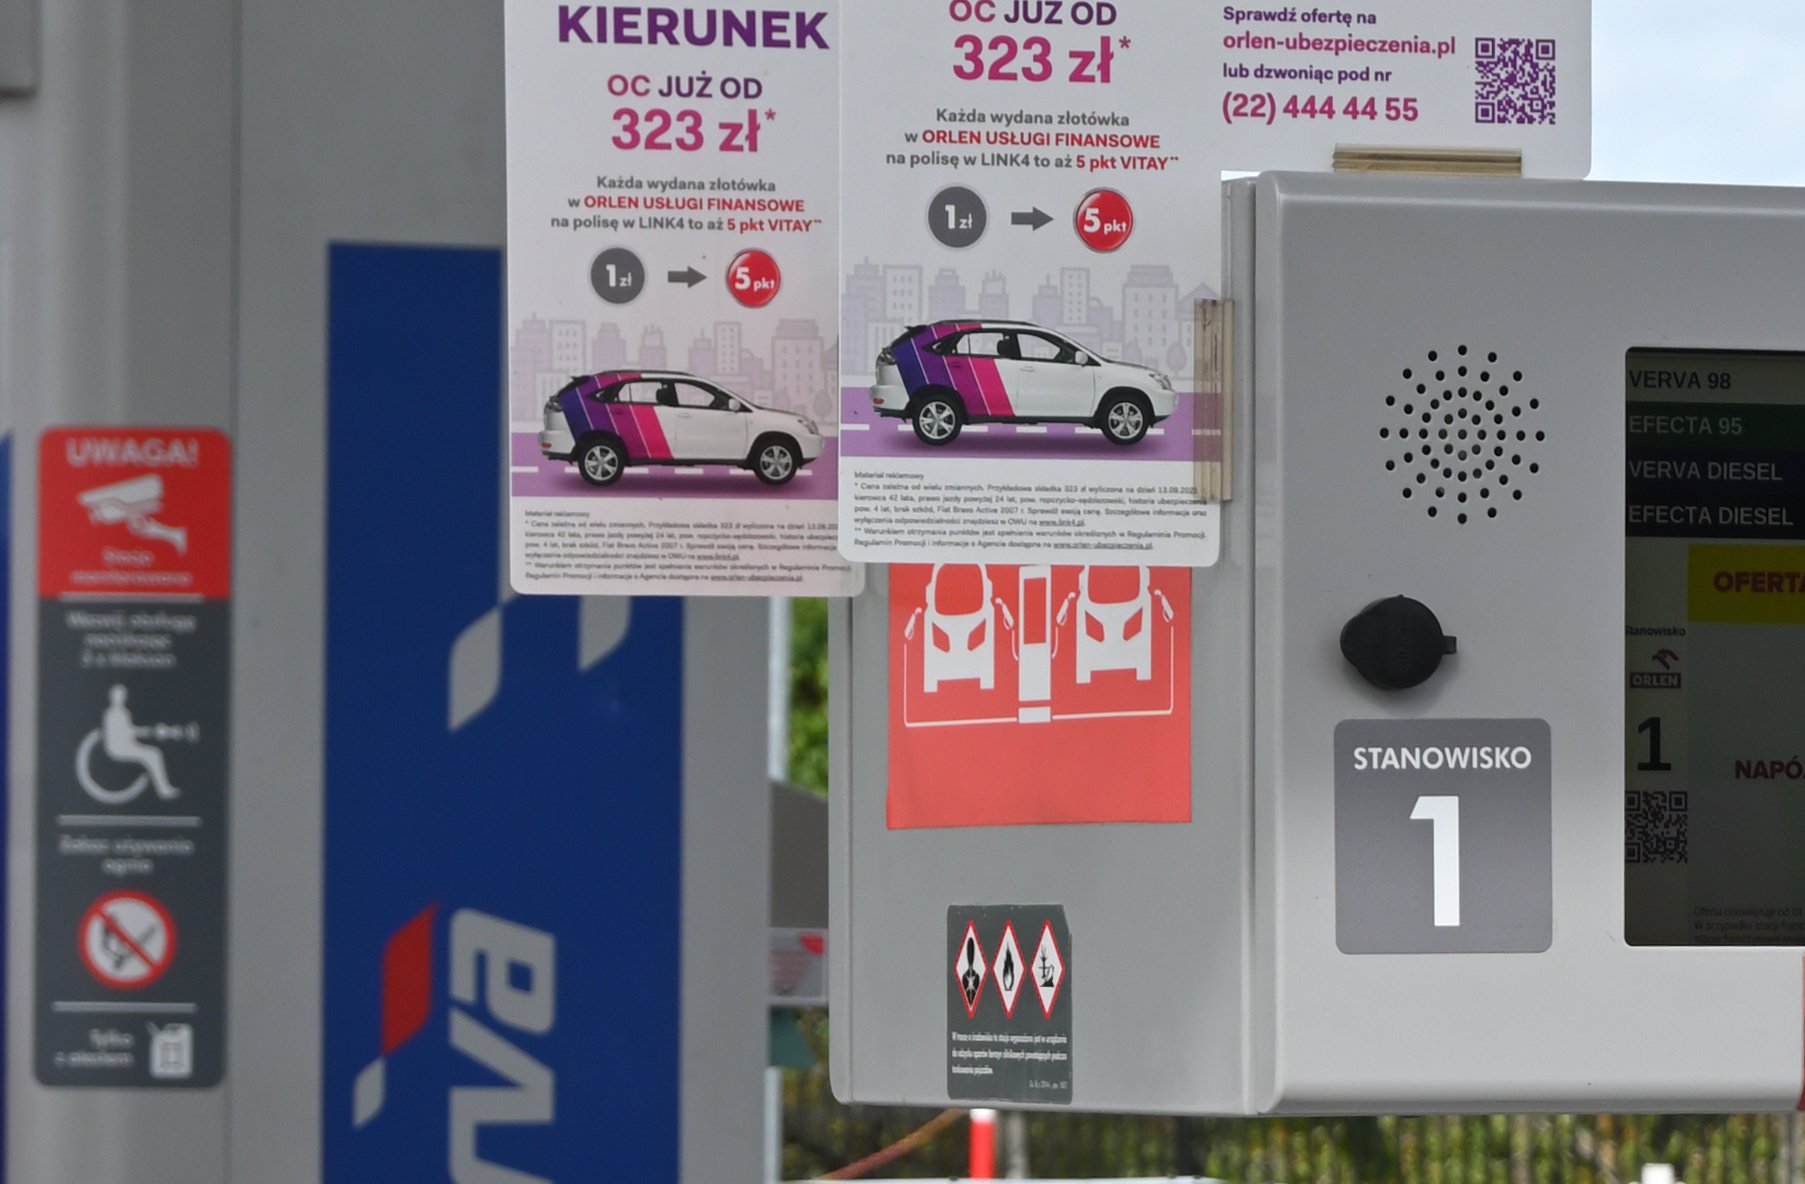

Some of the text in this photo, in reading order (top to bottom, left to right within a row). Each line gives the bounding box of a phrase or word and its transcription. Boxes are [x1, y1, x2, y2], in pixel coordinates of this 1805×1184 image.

[949, 0, 995, 23] OC
[1070, 1, 1117, 26] OD
[1223, 6, 1376, 28] Sprawdź ofertę na
[558, 5, 829, 49] KIERUNEK
[1223, 32, 1455, 58] orlen-ubezpieczenia.pl
[953, 34, 1053, 81] 323
[607, 71, 762, 99] OC JUŻ OD
[1223, 63, 1392, 84] lub dzwoniąc pod nr
[936, 108, 1130, 127] Każda wydana złotówka
[1222, 91, 1418, 124] (22) 444 44 55
[611, 107, 704, 151] 323
[905, 130, 1160, 148] w ORLEN USŁUGI FINANSOWE
[886, 154, 905, 164] na
[910, 151, 959, 169] polisę
[963, 156, 977, 166] w
[981, 153, 1030, 167] LINK4
[1034, 156, 1050, 168] to
[1055, 154, 1072, 168] aż
[1076, 156, 1085, 169] 5
[1090, 154, 1116, 172] pkt
[597, 175, 776, 192] Każda wydana złotówka
[568, 196, 805, 212] w ORLEN USŁUGI FINANSOWE
[551, 218, 569, 228] na
[573, 215, 618, 232] polisę
[623, 220, 635, 229] w
[639, 216, 685, 230] LINK4
[688, 219, 704, 230] to
[707, 217, 724, 231] aż
[727, 218, 736, 231] 5
[740, 218, 764, 234] pkt
[945, 205, 973, 229] 1 zł
[1083, 208, 1127, 235] 5 pkt
[606, 264, 632, 287] 1 zł
[734, 266, 775, 292] 5 pkt
[1629, 370, 1731, 390] VERVA 98
[1629, 415, 1742, 436] EFECTA 95
[1629, 459, 1783, 481] VERVA DIESEL
[1629, 505, 1794, 527] EFECTA DIESEL
[1631, 673, 1680, 687] ORLEN
[1636, 716, 1672, 771] 1
[1353, 747, 1532, 770] STANOWISKO
[1409, 795, 1460, 927] 1
